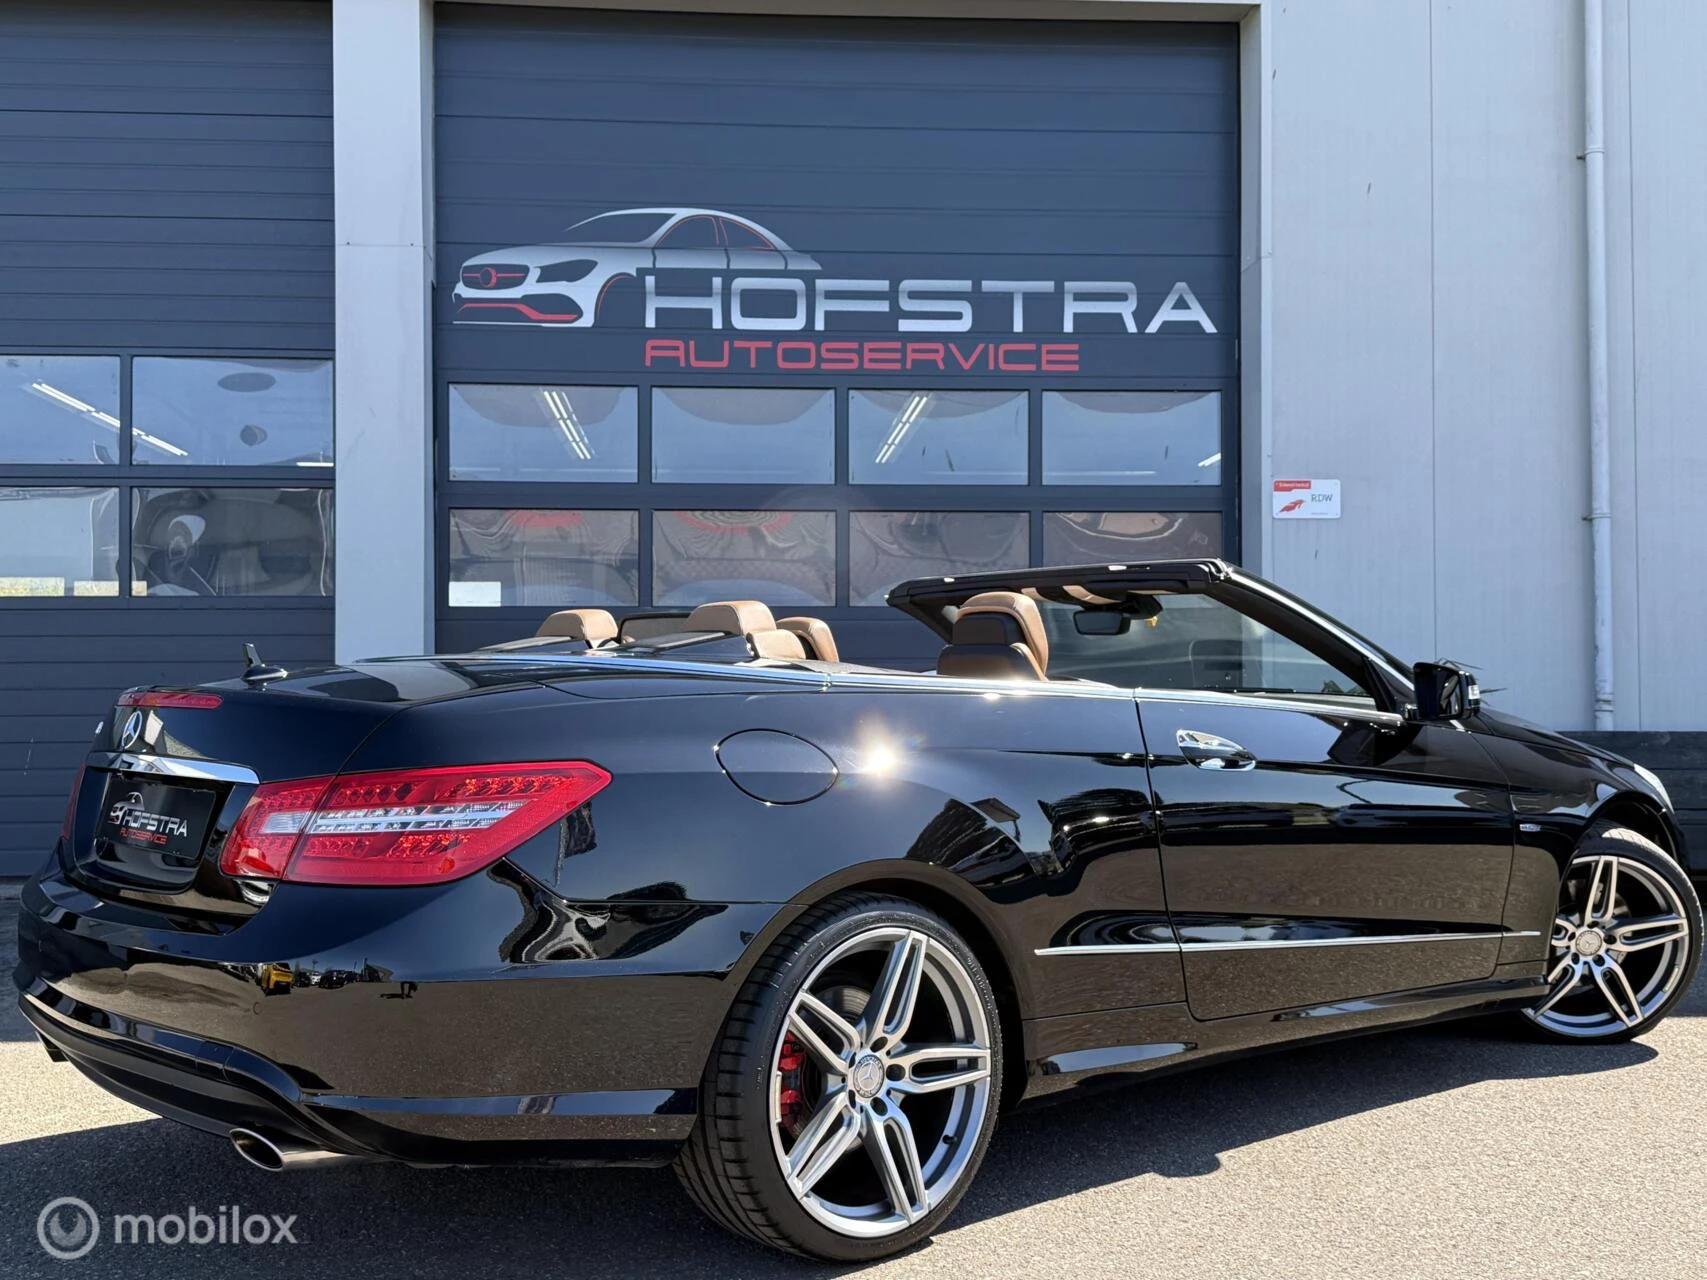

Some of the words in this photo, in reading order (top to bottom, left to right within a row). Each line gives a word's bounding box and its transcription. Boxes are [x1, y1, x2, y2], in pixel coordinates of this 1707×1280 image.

[645, 275, 1218, 333] HOFSTRA
[645, 339, 1080, 372] AUTOSERVICE
[1311, 494, 1333, 502] RDW
[120, 827, 167, 845] AUTOSERVICE
[122, 810, 187, 837] HOFSTRA
